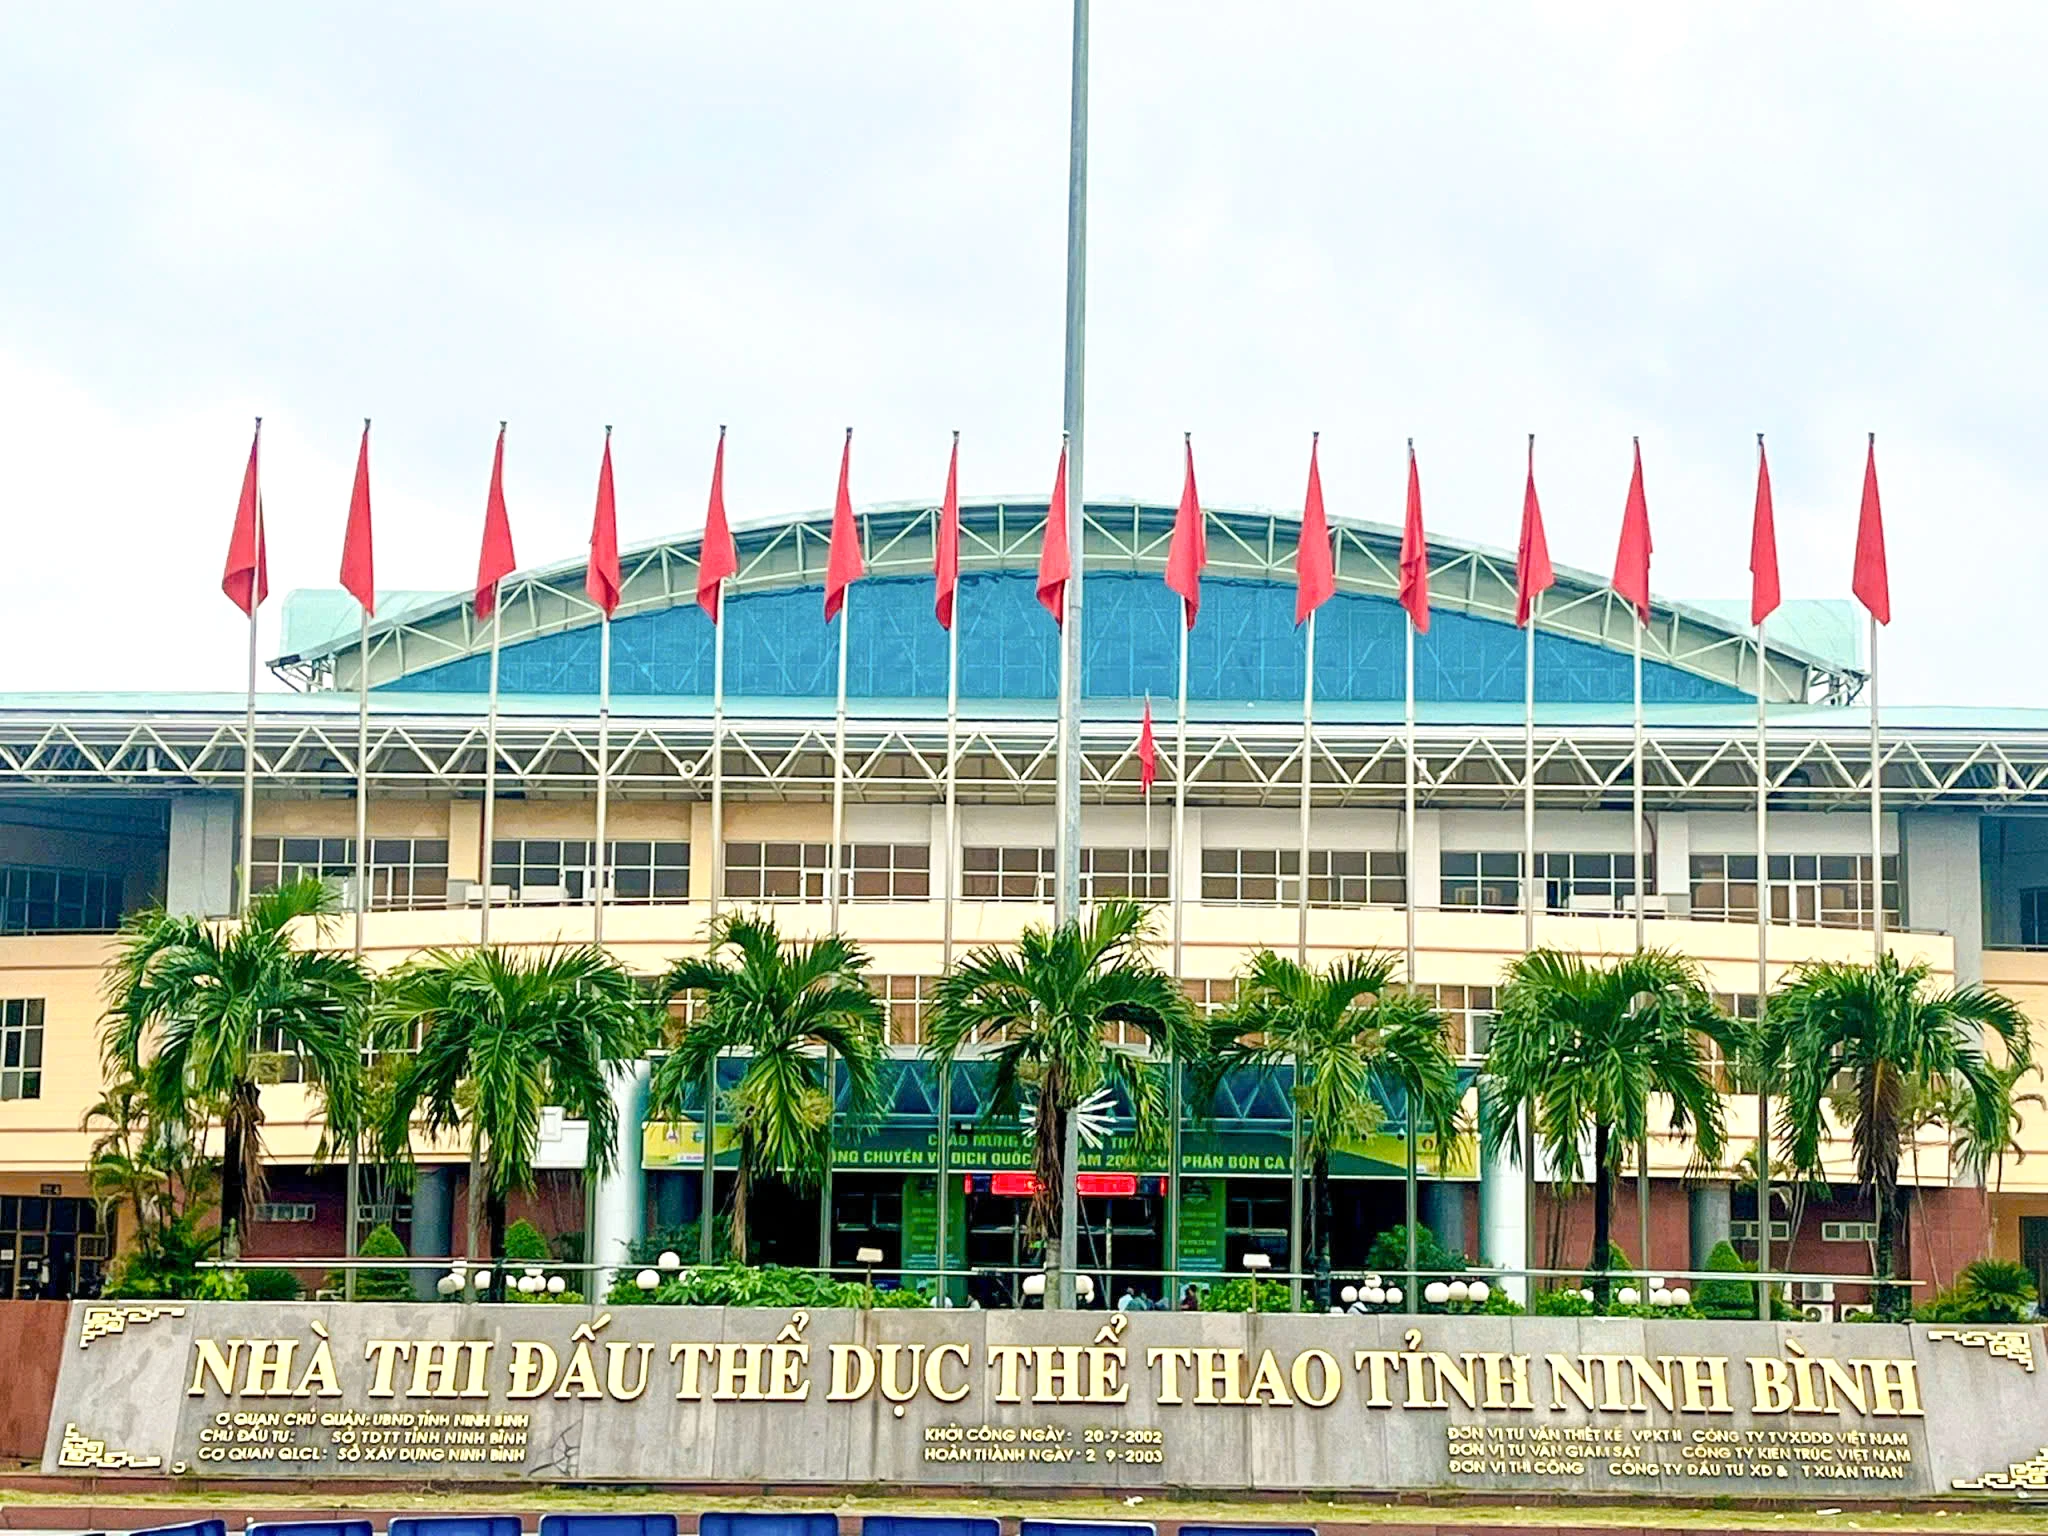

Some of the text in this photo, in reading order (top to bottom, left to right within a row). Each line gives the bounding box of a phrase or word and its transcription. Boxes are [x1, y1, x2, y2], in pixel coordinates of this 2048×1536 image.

[1182, 1153, 1223, 1169] PHÂN
[187, 1313, 1925, 1417] NHÀ THI ĐẤU THỂ DỤC THỂ THAO TỈNH NINH BÌNH
[234, 1412, 280, 1426] QUAN
[283, 1406, 316, 1426] CHỦ
[373, 1413, 414, 1426] UBND
[418, 1409, 449, 1427] TỈNH
[453, 1413, 490, 1427] NINH
[200, 1425, 234, 1442] CHỦ
[362, 1431, 400, 1444] TDTT
[404, 1426, 440, 1444] TỈNH
[444, 1432, 485, 1444] NINH
[925, 1422, 963, 1441] KHỞI
[966, 1424, 1016, 1442] CÔNG
[1084, 1429, 1163, 1444] 20-7-2002
[1692, 1428, 1739, 1442] CÔNG
[1746, 1431, 1764, 1443] TY
[1836, 1430, 1866, 1447] VIỆT
[1869, 1432, 1908, 1445] NAM
[198, 1447, 225, 1461] CƠ
[228, 1447, 274, 1460] QUAN
[364, 1446, 396, 1461] XÂY
[448, 1448, 486, 1461] NINH
[924, 1443, 972, 1461] HOÀN
[1682, 1443, 1731, 1459] CÔNG
[1735, 1447, 1754, 1460] TY
[1872, 1448, 1911, 1462] NAM
[1534, 1458, 1585, 1475] CÔNG
[1609, 1459, 1660, 1475] CÔNG
[1664, 1463, 1683, 1476] TY
[1750, 1464, 1773, 1478] XD
[1776, 1464, 1788, 1479] &
[1813, 1463, 1859, 1479] XUÂN
